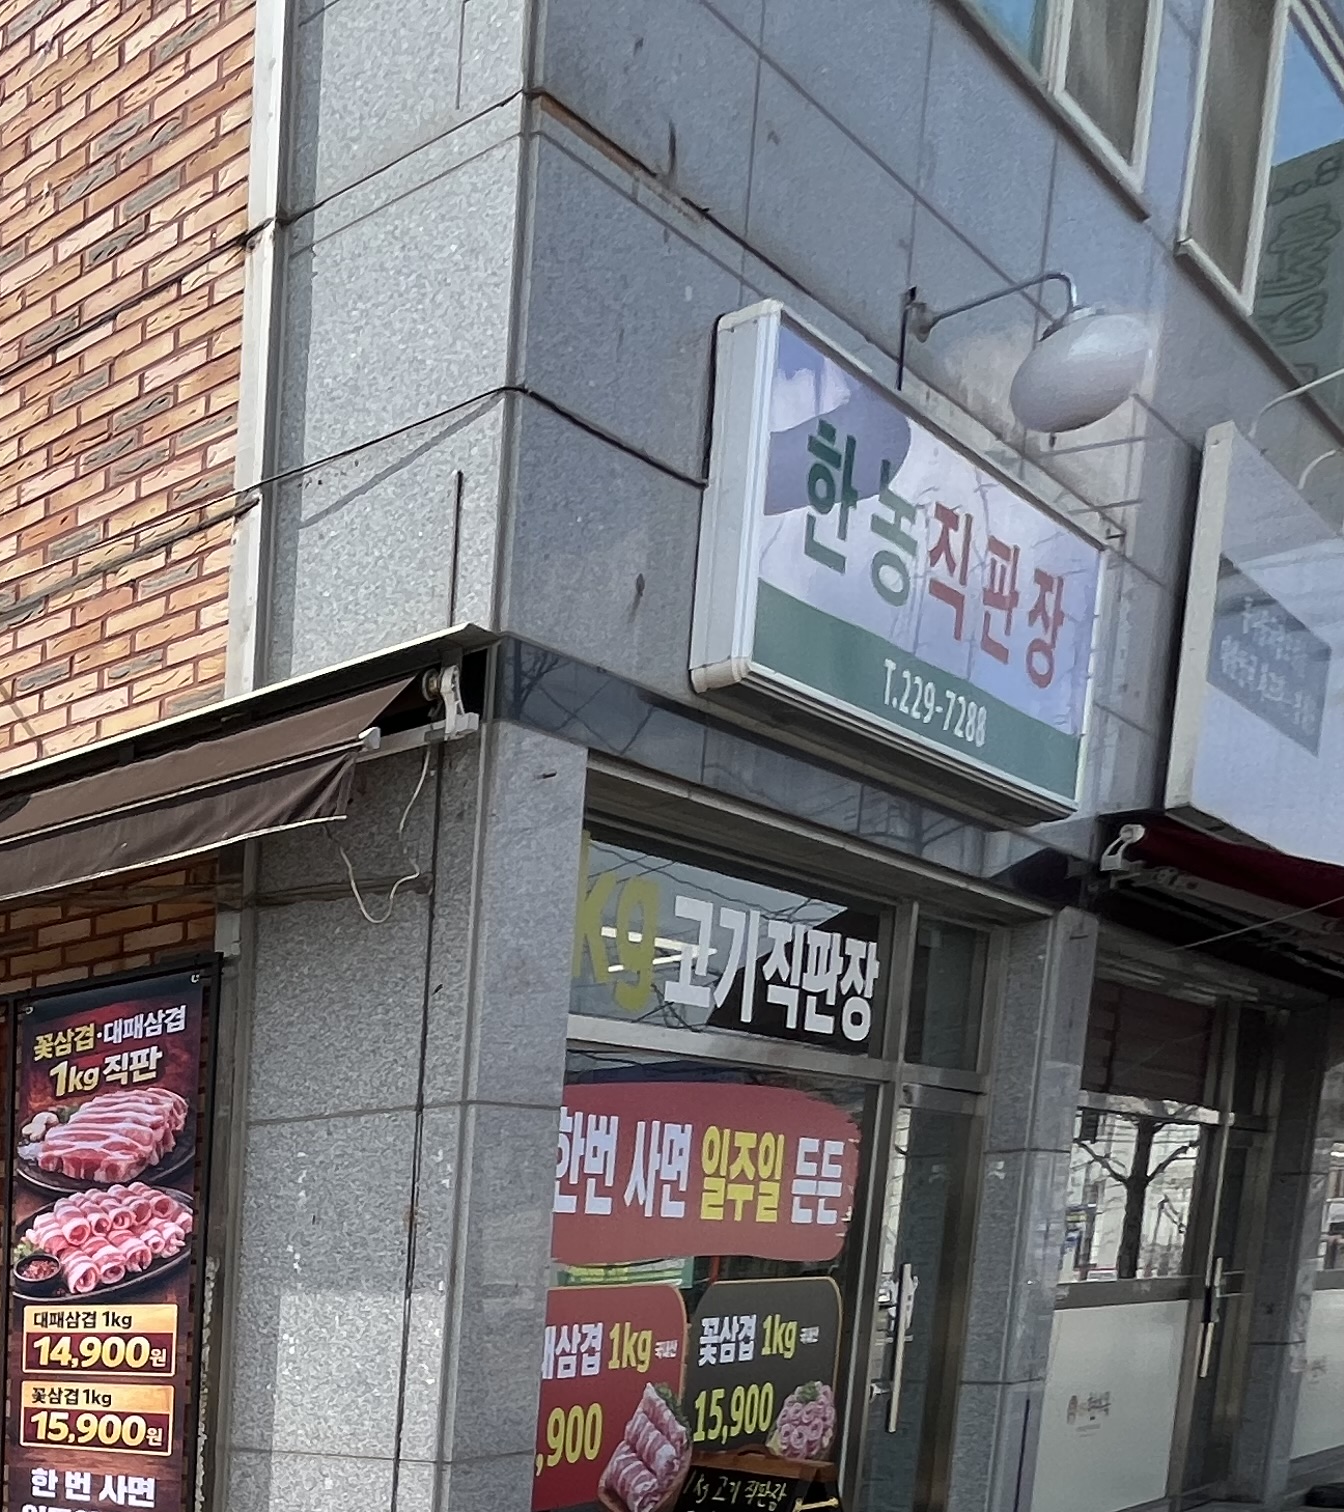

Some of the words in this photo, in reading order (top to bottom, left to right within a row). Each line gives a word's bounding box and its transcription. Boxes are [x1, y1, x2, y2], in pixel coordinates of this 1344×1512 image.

[882, 657, 987, 747] T.229-7288
[49, 1060, 99, 1097] 1kg
[103, 1045, 163, 1085] 직판
[553, 1106, 619, 1216] 한번
[623, 1119, 693, 1219] 사면
[700, 1125, 785, 1223] 일주일
[791, 1137, 844, 1225] 든든
[33, 1311, 97, 1329] 대패삼겹
[102, 1311, 133, 1329] 1kg
[698, 1314, 757, 1367] 꽃삼겹
[761, 1313, 797, 1359] 1kg
[33, 1335, 167, 1369] 14,900원
[607, 1321, 652, 1374] 1kg
[31, 1387, 80, 1406] 꽃삼겹
[82, 1389, 112, 1407] 1kg
[693, 1382, 774, 1445] 15,900
[30, 1410, 163, 1447] 15,900원
[31, 1467, 58, 1498] 한
[65, 1470, 91, 1502] 번
[98, 1474, 156, 1508] 사면
[711, 1475, 742, 1504] 고기
[744, 1480, 787, 1511] 직판장
